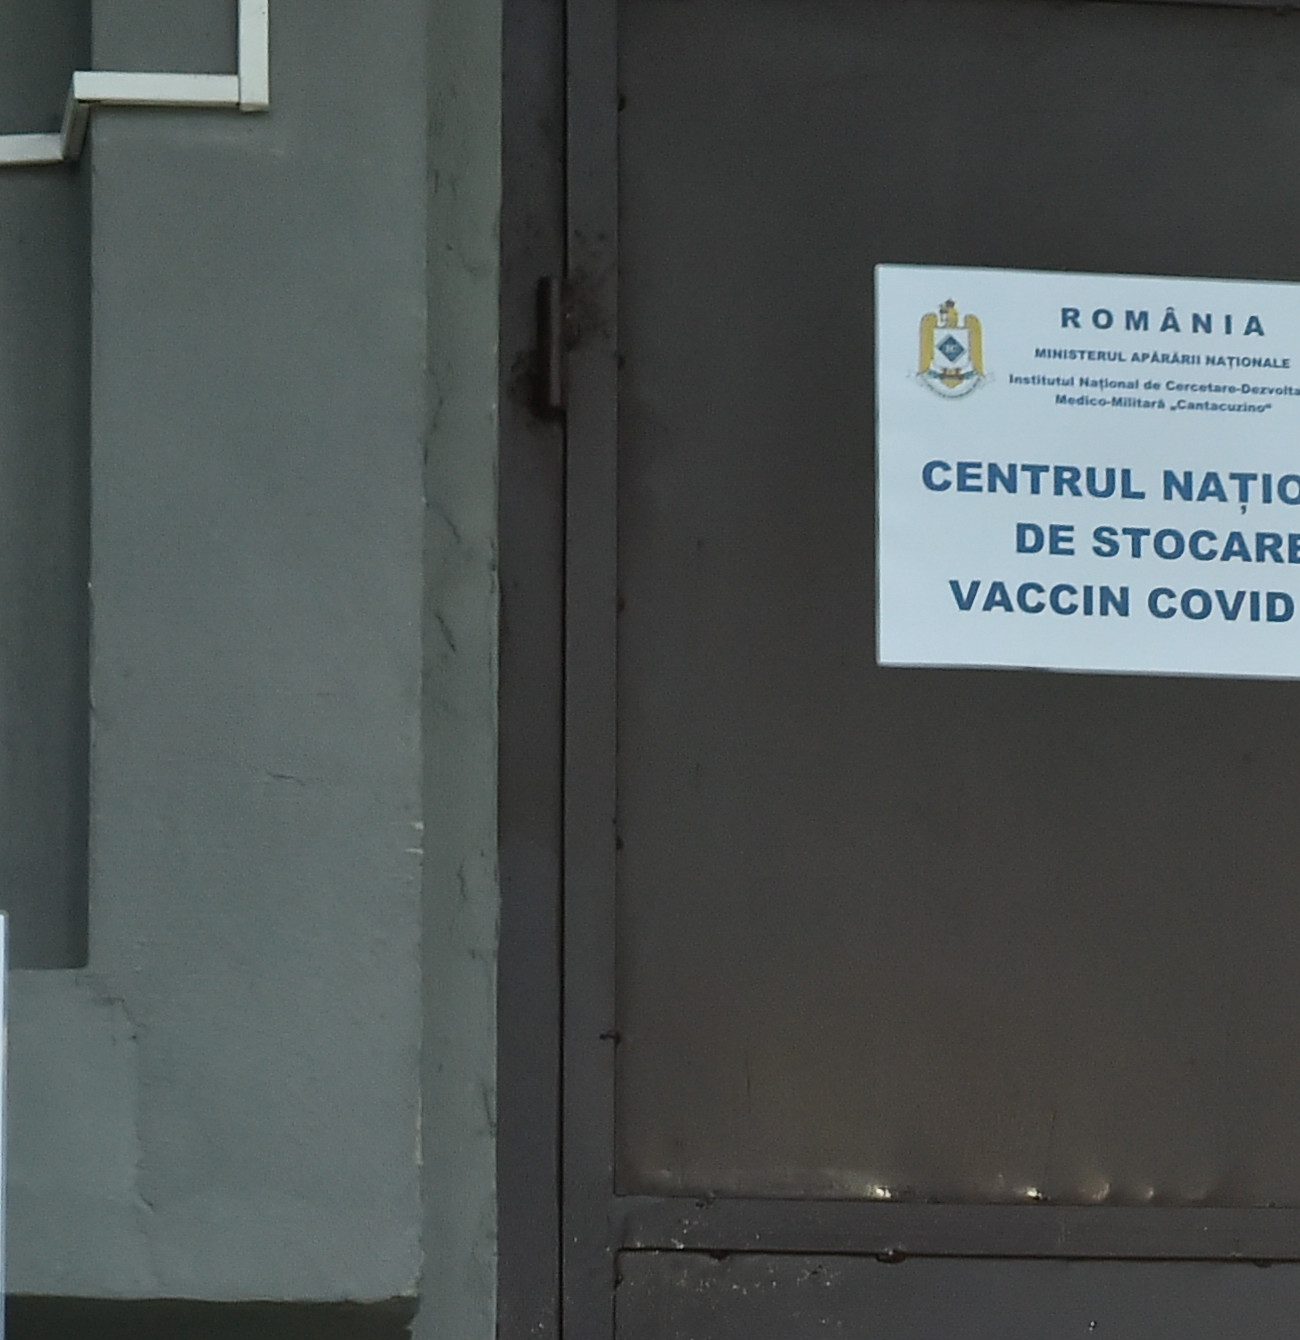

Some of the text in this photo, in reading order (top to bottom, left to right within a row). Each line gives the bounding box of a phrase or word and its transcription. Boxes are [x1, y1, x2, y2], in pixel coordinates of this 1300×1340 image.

[1060, 306, 1266, 337] ROMÂNIA
[1034, 348, 1127, 363] MINISTERUL
[1008, 373, 1075, 387] Institutul
[1143, 379, 1161, 391] de
[921, 459, 1146, 501] CENTRUL
[1015, 522, 1076, 558] DE
[948, 579, 1131, 619] VACCIN
[1146, 585, 1296, 624] COVID
